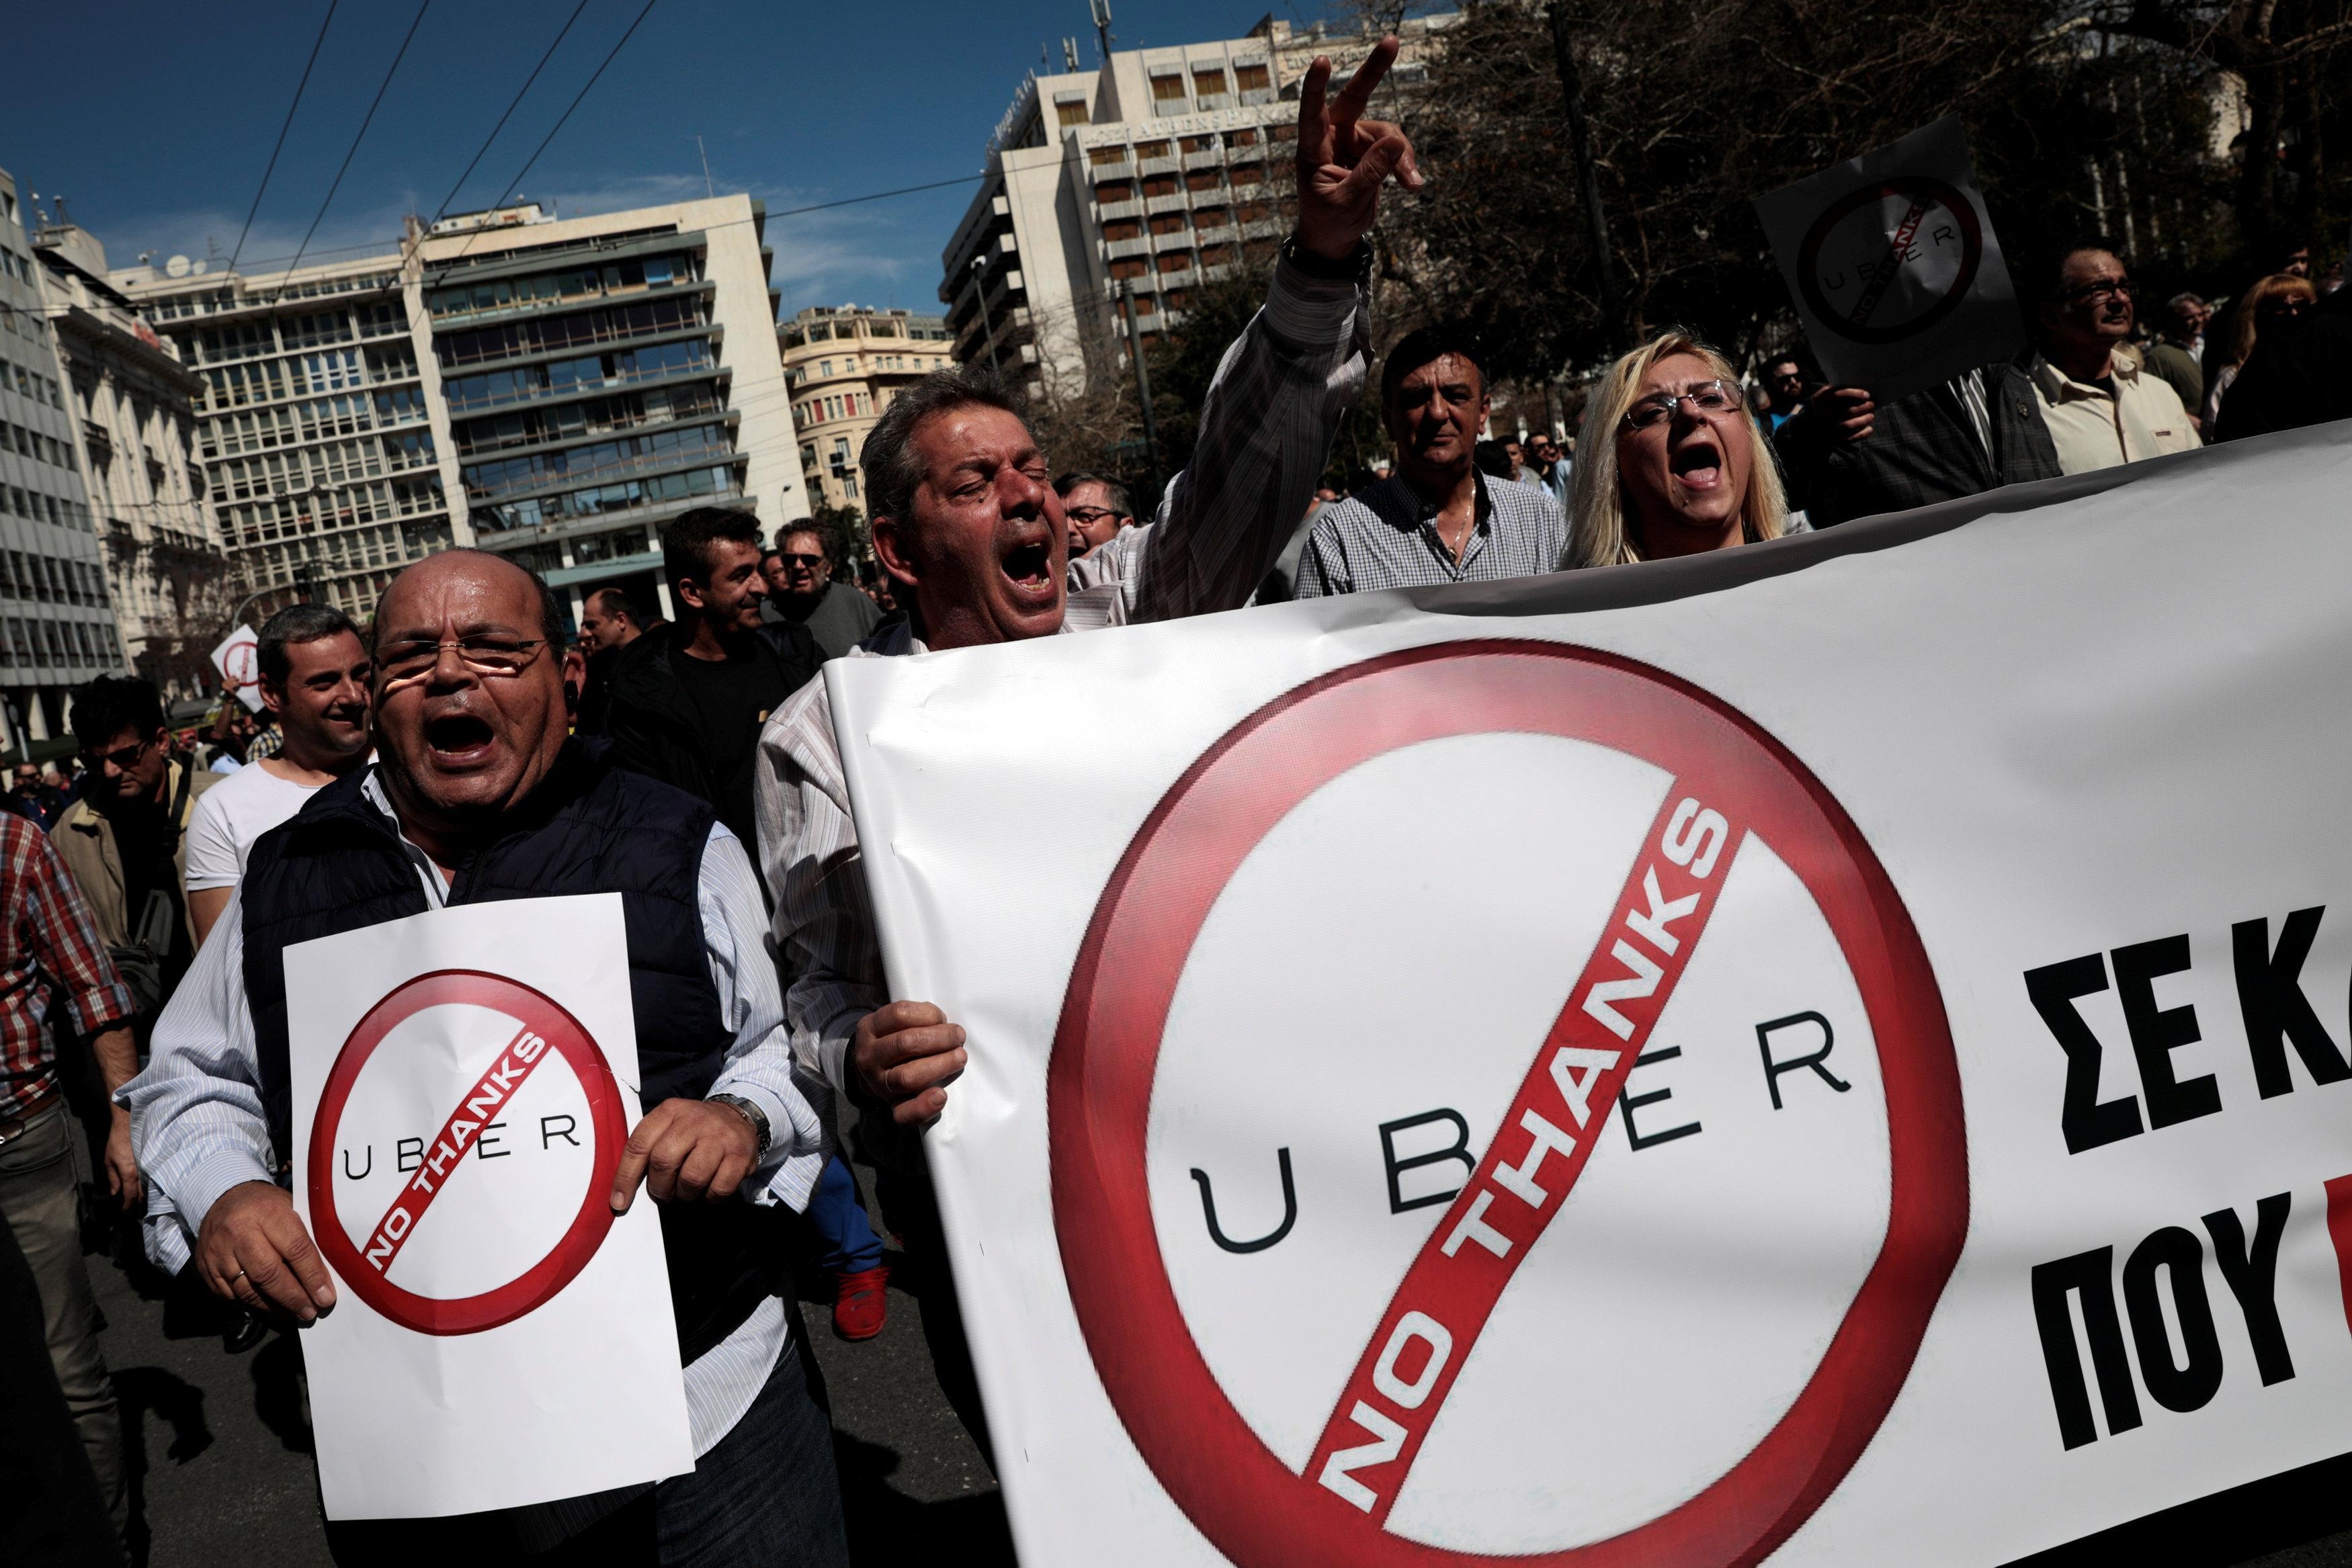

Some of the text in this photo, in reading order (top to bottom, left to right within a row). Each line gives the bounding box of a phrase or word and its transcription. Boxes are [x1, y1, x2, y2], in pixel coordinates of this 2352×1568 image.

[1138, 114, 1221, 138] ATHENS
[1824, 226, 1955, 290] UBER
[1851, 195, 1929, 325] NO THANKS
[344, 1115, 580, 1180] UBER
[1190, 1010, 1851, 1254] UBER
[2023, 905, 2352, 1155] ΣΕ Κ
[366, 1032, 545, 1271] NO THANKS
[1317, 797, 1729, 1514] NO THANKS
[2031, 1191, 2296, 1452] ΠΟΥ
